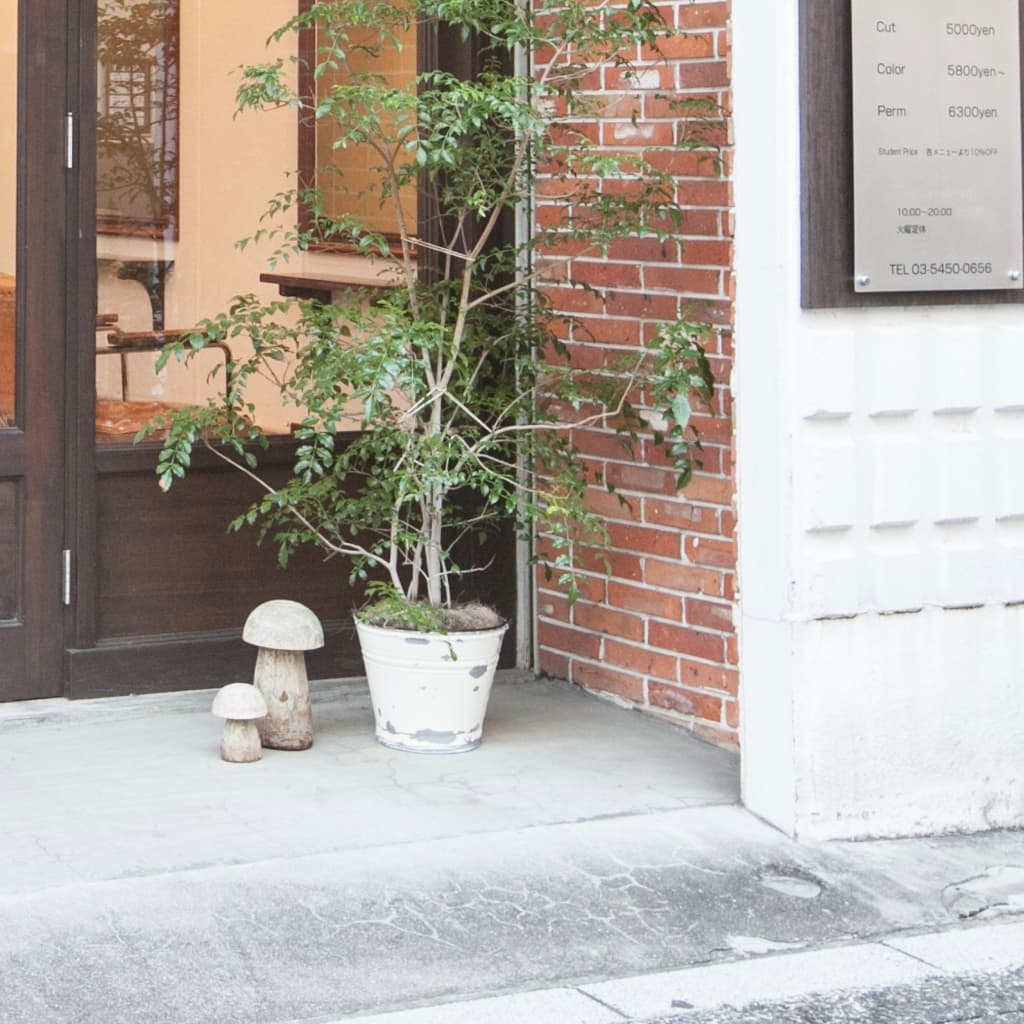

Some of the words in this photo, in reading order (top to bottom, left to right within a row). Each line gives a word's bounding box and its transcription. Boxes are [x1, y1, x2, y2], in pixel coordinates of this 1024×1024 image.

[876, 21, 896, 33] Cut
[946, 23, 995, 37] 5000yen
[877, 63, 906, 75] Color
[877, 105, 907, 117] Perm
[948, 106, 997, 119] 6300yen
[889, 263, 909, 275] TEL
[911, 261, 992, 275] 03-5450-0656
